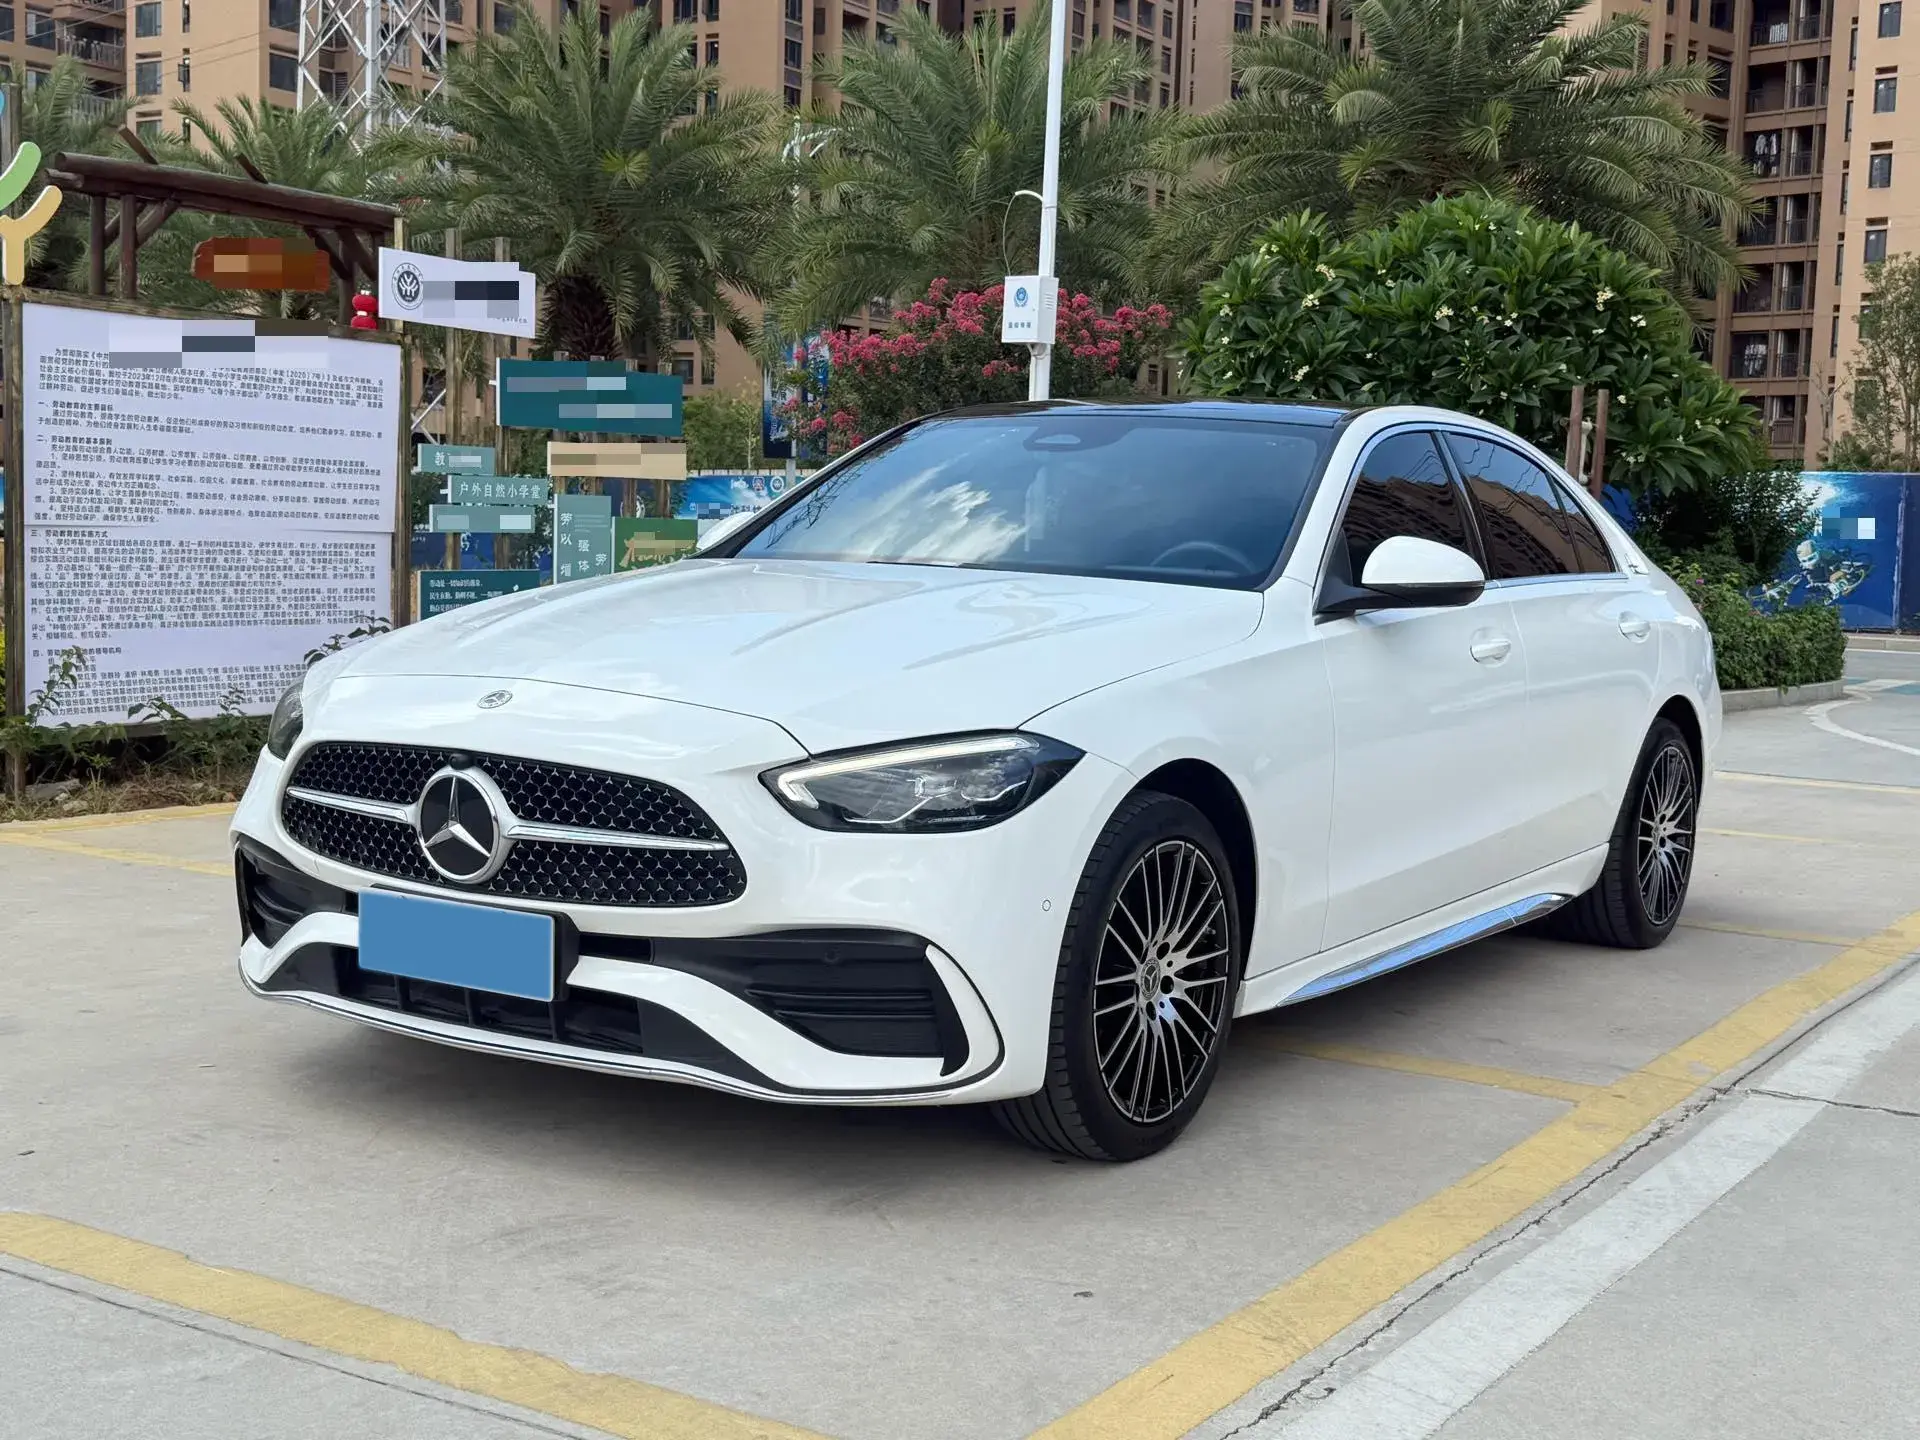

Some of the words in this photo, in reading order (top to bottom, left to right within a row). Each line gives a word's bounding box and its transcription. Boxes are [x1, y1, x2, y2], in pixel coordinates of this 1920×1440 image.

[458, 482, 541, 499] 户外自然小学堂
